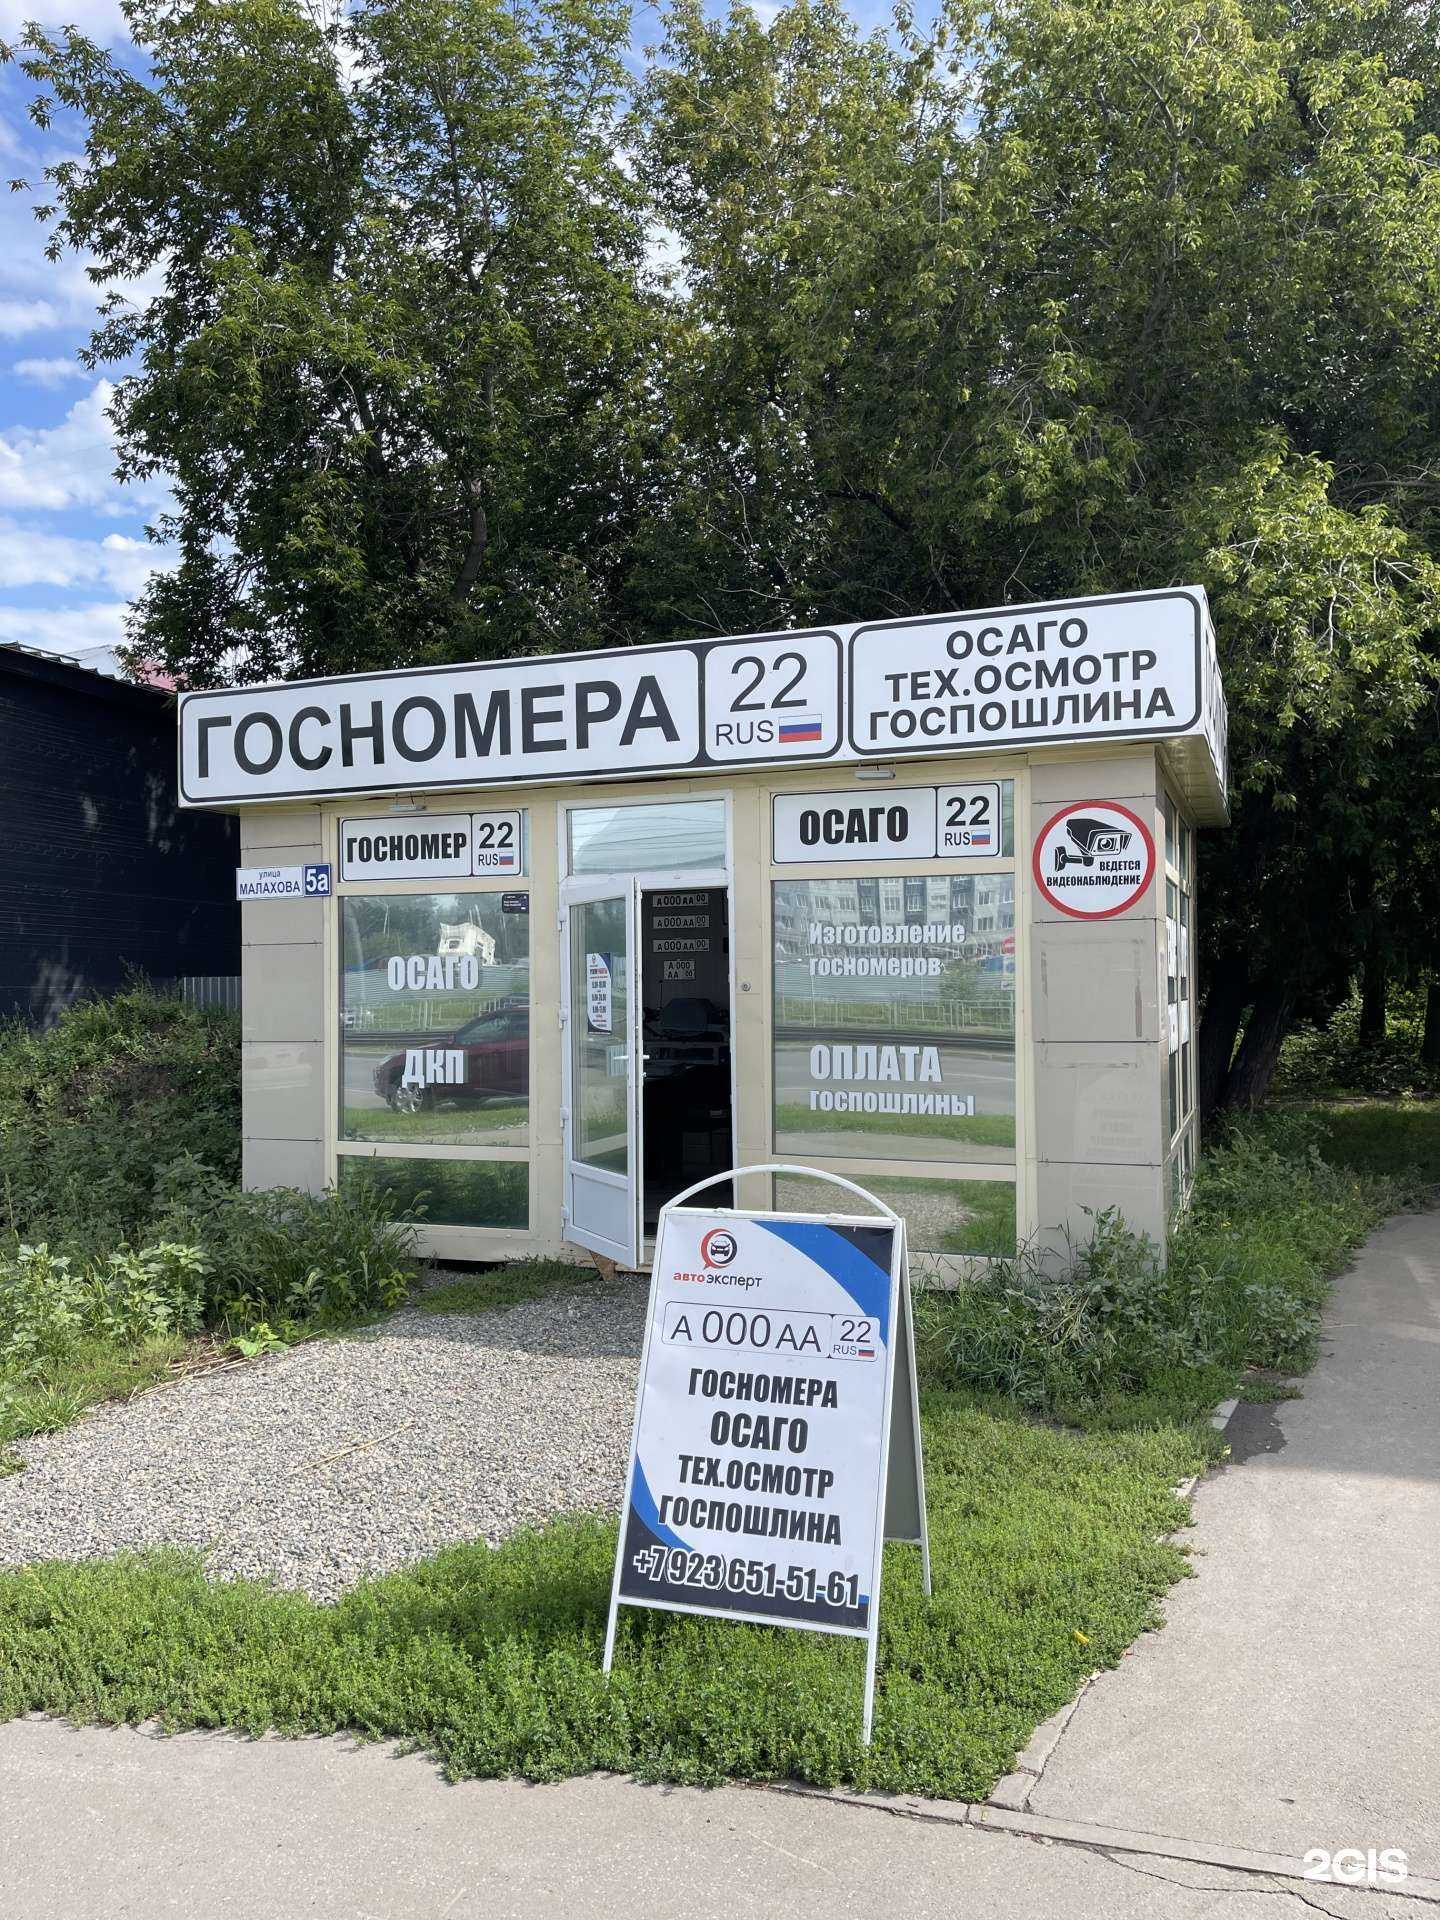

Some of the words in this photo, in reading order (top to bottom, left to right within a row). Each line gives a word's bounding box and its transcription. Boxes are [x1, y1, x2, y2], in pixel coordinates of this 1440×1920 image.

[945, 617, 1089, 660] ОСАГО
[729, 652, 809, 713] 22
[884, 649, 1157, 703] ТЕХ.ОСМОТР
[196, 674, 681, 779] ГОСНОМЕРА
[869, 687, 1176, 741] ГОСПОШЛИНА
[715, 719, 775, 747] RUS
[799, 805, 909, 846] ОСАГО
[945, 795, 990, 827] 22
[346, 832, 467, 863] ГОСНОМЕР
[478, 821, 514, 849] 22
[944, 831, 971, 846] RUS
[258, 870, 281, 880] улица
[478, 853, 499, 866] RUS
[1099, 860, 1141, 872] ВЕДЕТСЯ
[239, 881, 301, 895] МАЛАХОВА
[306, 868, 329, 892] 5а
[1046, 874, 1141, 888] ВИДЕОНАБЛЮДЕНИЕ
[808, 922, 967, 945] Изготовление
[387, 955, 480, 991] ОСАГО
[808, 956, 942, 978] госномеров
[401, 1049, 466, 1089] ДКП
[809, 1044, 943, 1083] ОПЛАТА
[808, 1089, 976, 1117] госпошлины
[839, 1319, 872, 1344] 22
[832, 1344, 857, 1356] RUS
[688, 1367, 838, 1409] ГОСНОМЕРА
[710, 1410, 809, 1454] ОСАГО
[678, 1454, 834, 1499] ТЕХ.ОСМОТР
[658, 1494, 842, 1546] ГОСПОШЛИНА
